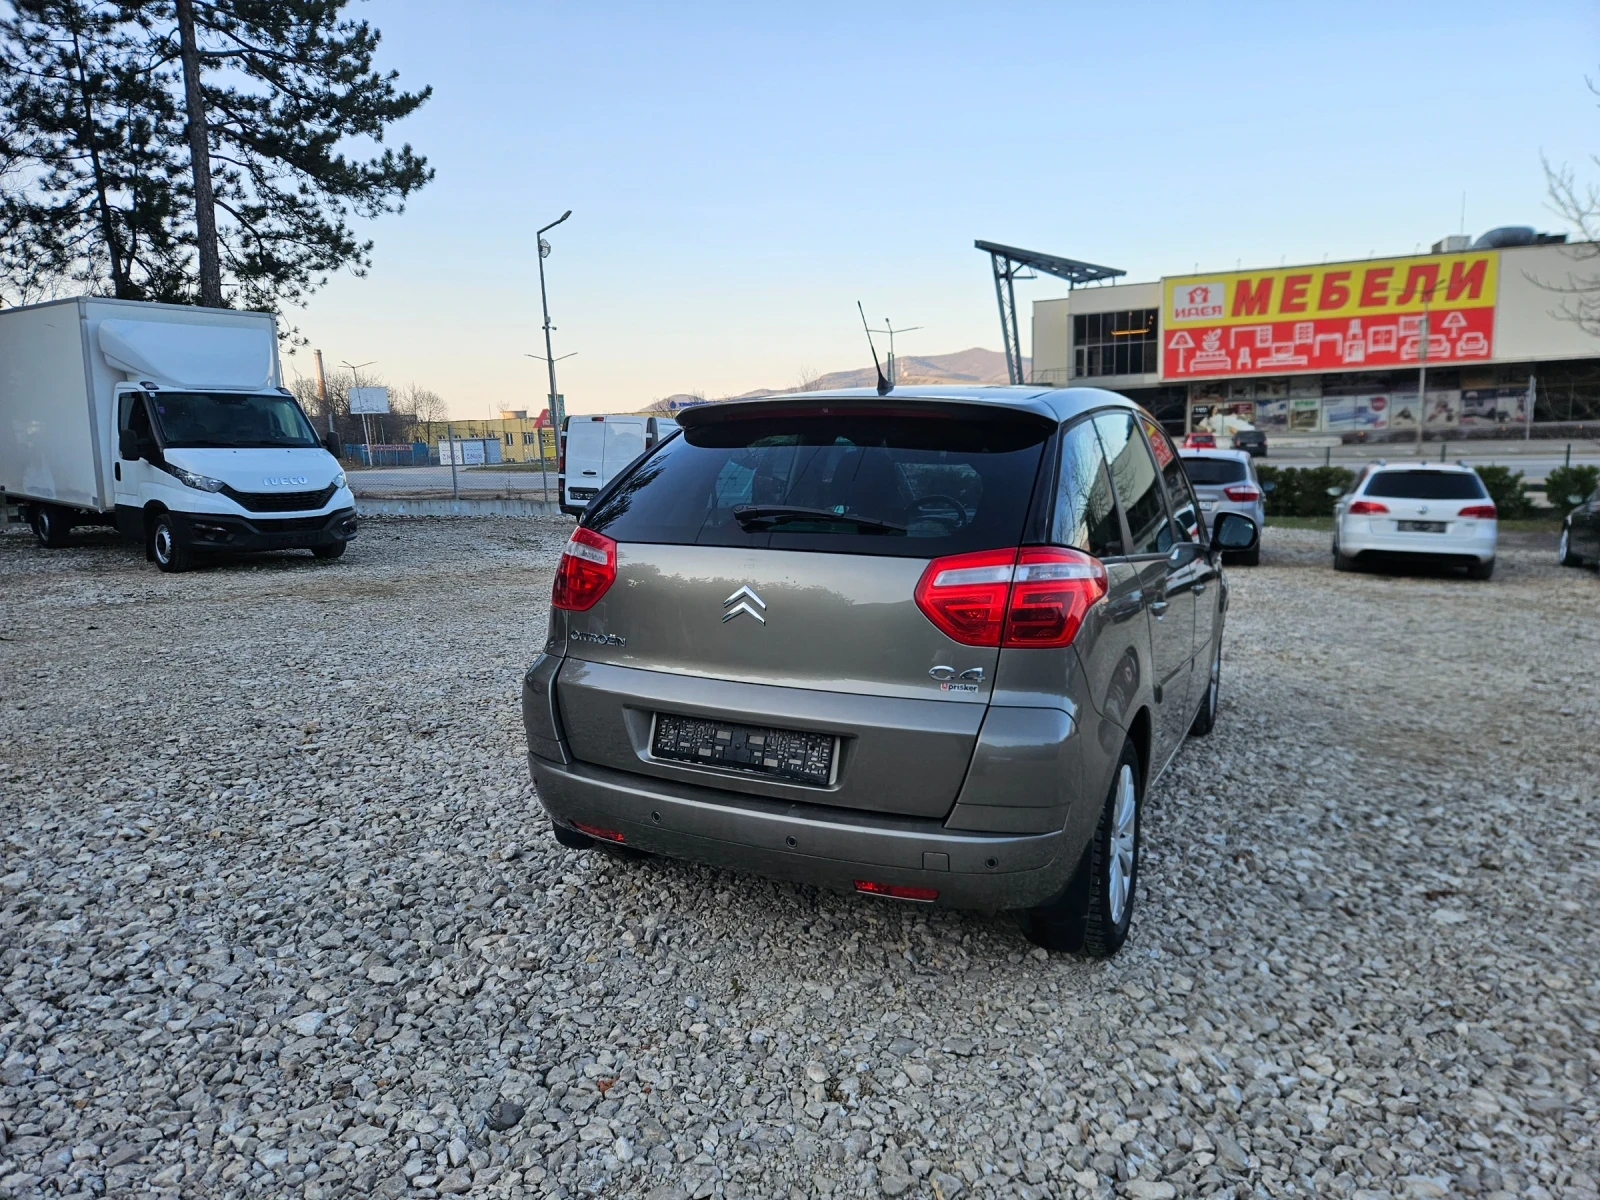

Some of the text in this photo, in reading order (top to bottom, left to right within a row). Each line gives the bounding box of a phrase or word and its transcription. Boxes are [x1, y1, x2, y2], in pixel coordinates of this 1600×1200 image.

[1231, 259, 1489, 317] МЕБЕЛИ
[1174, 305, 1222, 318] ИДЕЯ
[262, 476, 308, 486] IVECO
[928, 665, 986, 683] C4
